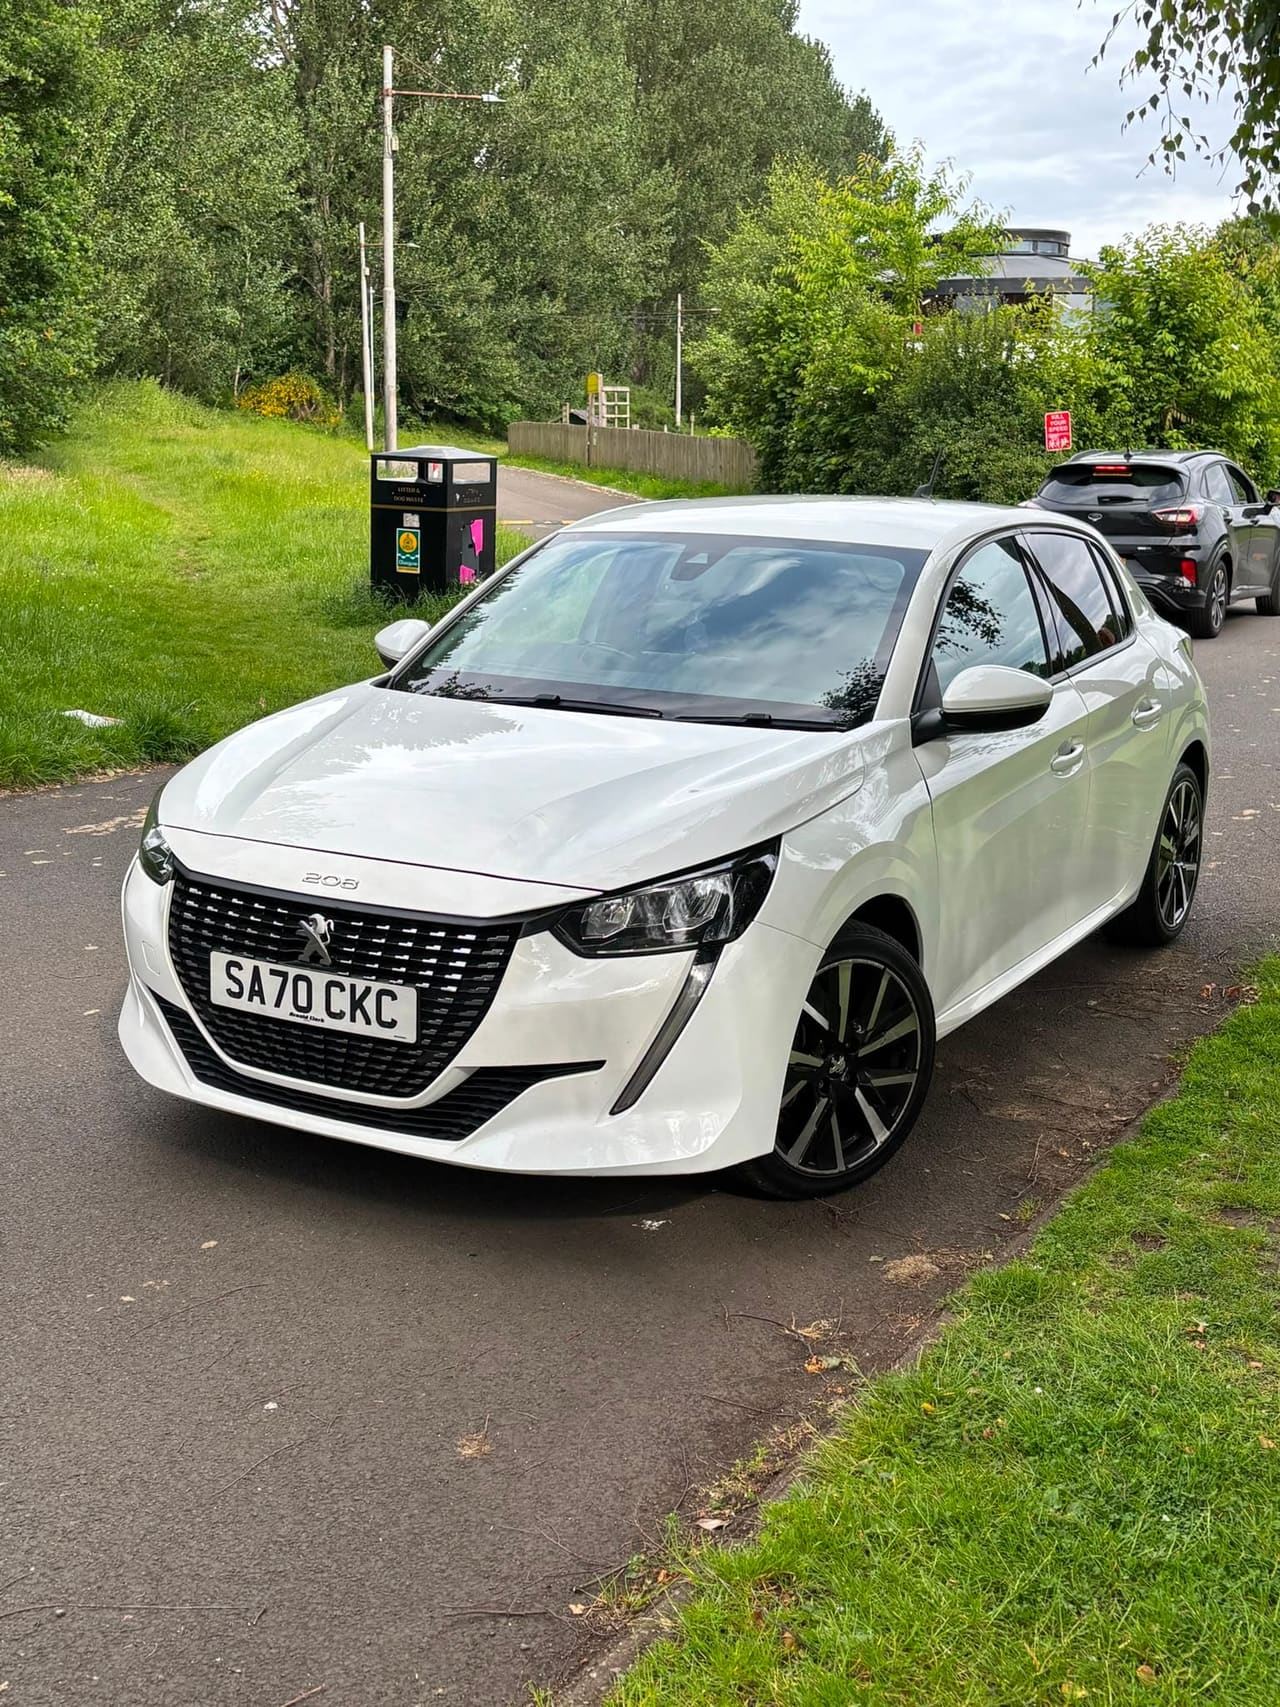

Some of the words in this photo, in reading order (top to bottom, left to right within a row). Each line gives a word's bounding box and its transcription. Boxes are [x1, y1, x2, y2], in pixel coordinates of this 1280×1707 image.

[393, 495, 406, 503] DOG
[302, 872, 359, 890] 208
[225, 959, 313, 1014] SA70
[324, 979, 398, 1029] CKC
[289, 1011, 309, 1020] Arnold
[309, 1015, 325, 1023] Clark
